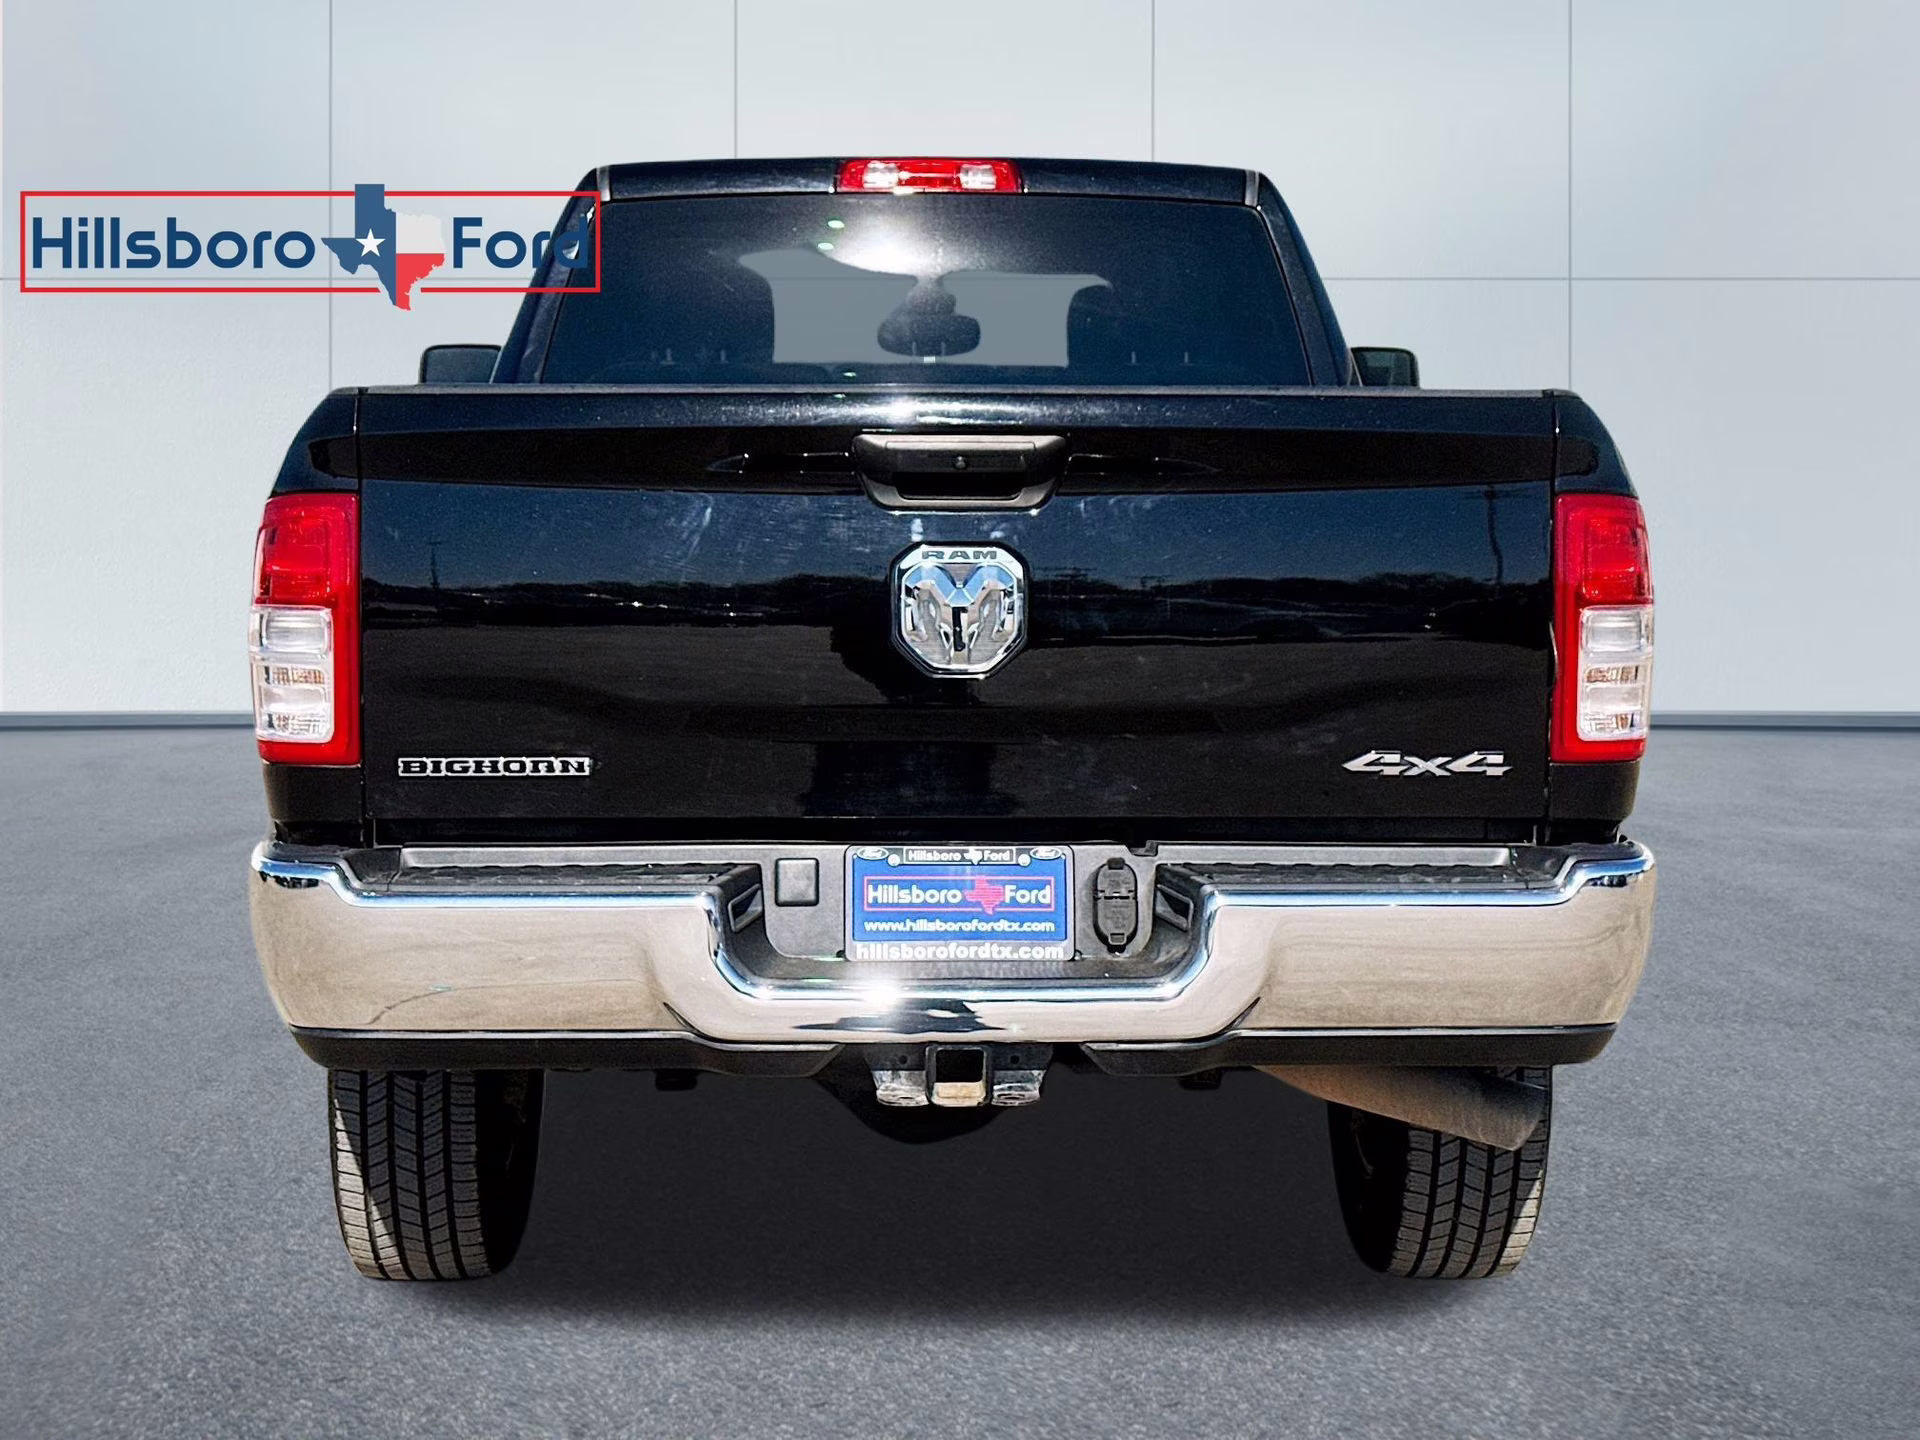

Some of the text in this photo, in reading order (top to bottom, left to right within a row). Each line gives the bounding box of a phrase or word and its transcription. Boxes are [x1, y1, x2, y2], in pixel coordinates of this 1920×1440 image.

[921, 550, 998, 560] RAM
[398, 757, 590, 776] BIGHORN
[1341, 750, 1514, 776] 4x4
[908, 850, 1011, 861] Hillsboro Ford
[867, 884, 1051, 904] Hillsboro Ford
[863, 919, 1056, 932] www.hillsborofordtx.com
[856, 943, 1064, 960] hillsborofordtx.com
